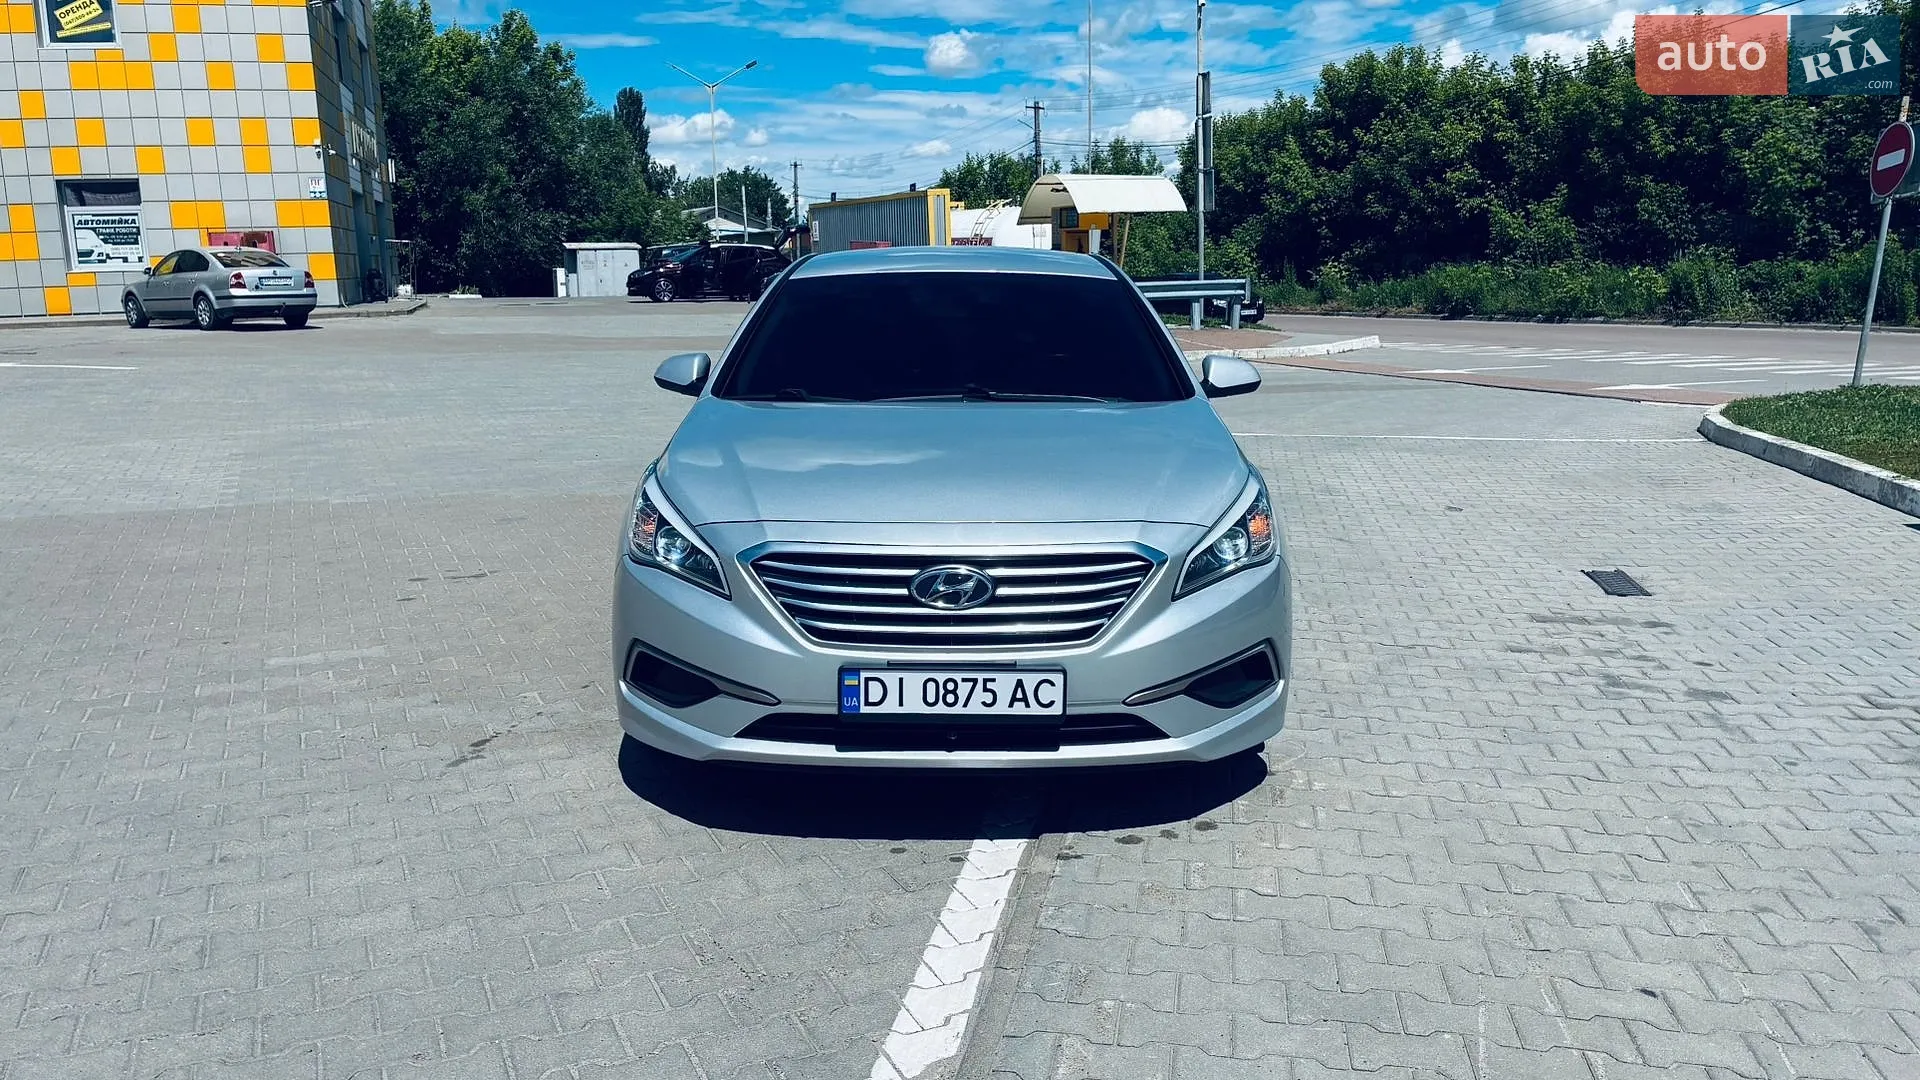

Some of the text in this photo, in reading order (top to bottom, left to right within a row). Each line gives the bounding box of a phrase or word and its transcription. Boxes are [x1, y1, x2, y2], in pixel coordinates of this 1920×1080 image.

[59, 0, 95, 19] ОРЕНДА
[76, 217, 137, 226] АВТОМИЙКА
[863, 676, 1057, 709] DI 0875 AC
[844, 697, 859, 707] UA
